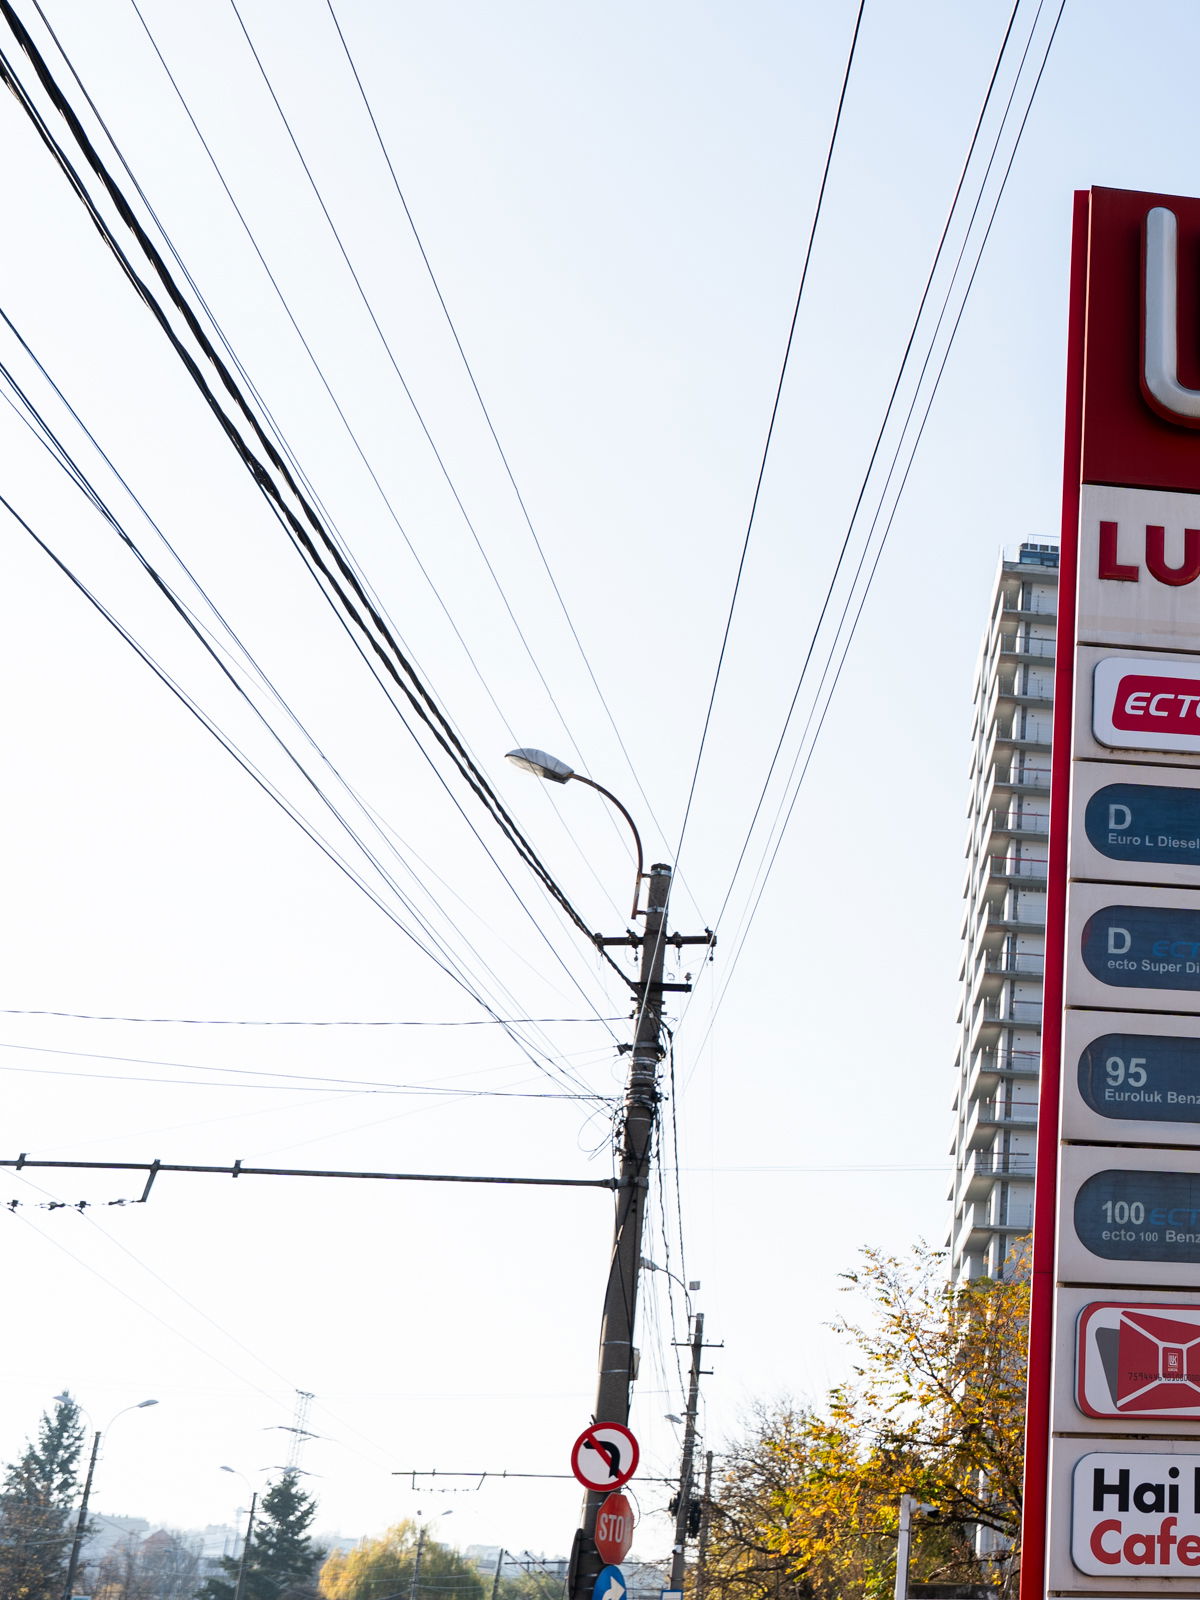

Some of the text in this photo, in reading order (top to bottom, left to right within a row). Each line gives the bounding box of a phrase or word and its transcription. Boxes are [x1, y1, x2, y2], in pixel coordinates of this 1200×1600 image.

[1108, 804, 1132, 830] D
[1107, 832, 1200, 850] Euro L Diesel
[1107, 926, 1132, 955] D
[1107, 959, 1137, 970] ecto
[1141, 959, 1182, 974] Super
[1105, 1055, 1148, 1088] 95
[1104, 1088, 1162, 1104] Euroluk
[1101, 1200, 1145, 1225] 100
[1102, 1228, 1136, 1242] ecto
[1139, 1231, 1159, 1243] 100
[1093, 1467, 1180, 1513] Hai
